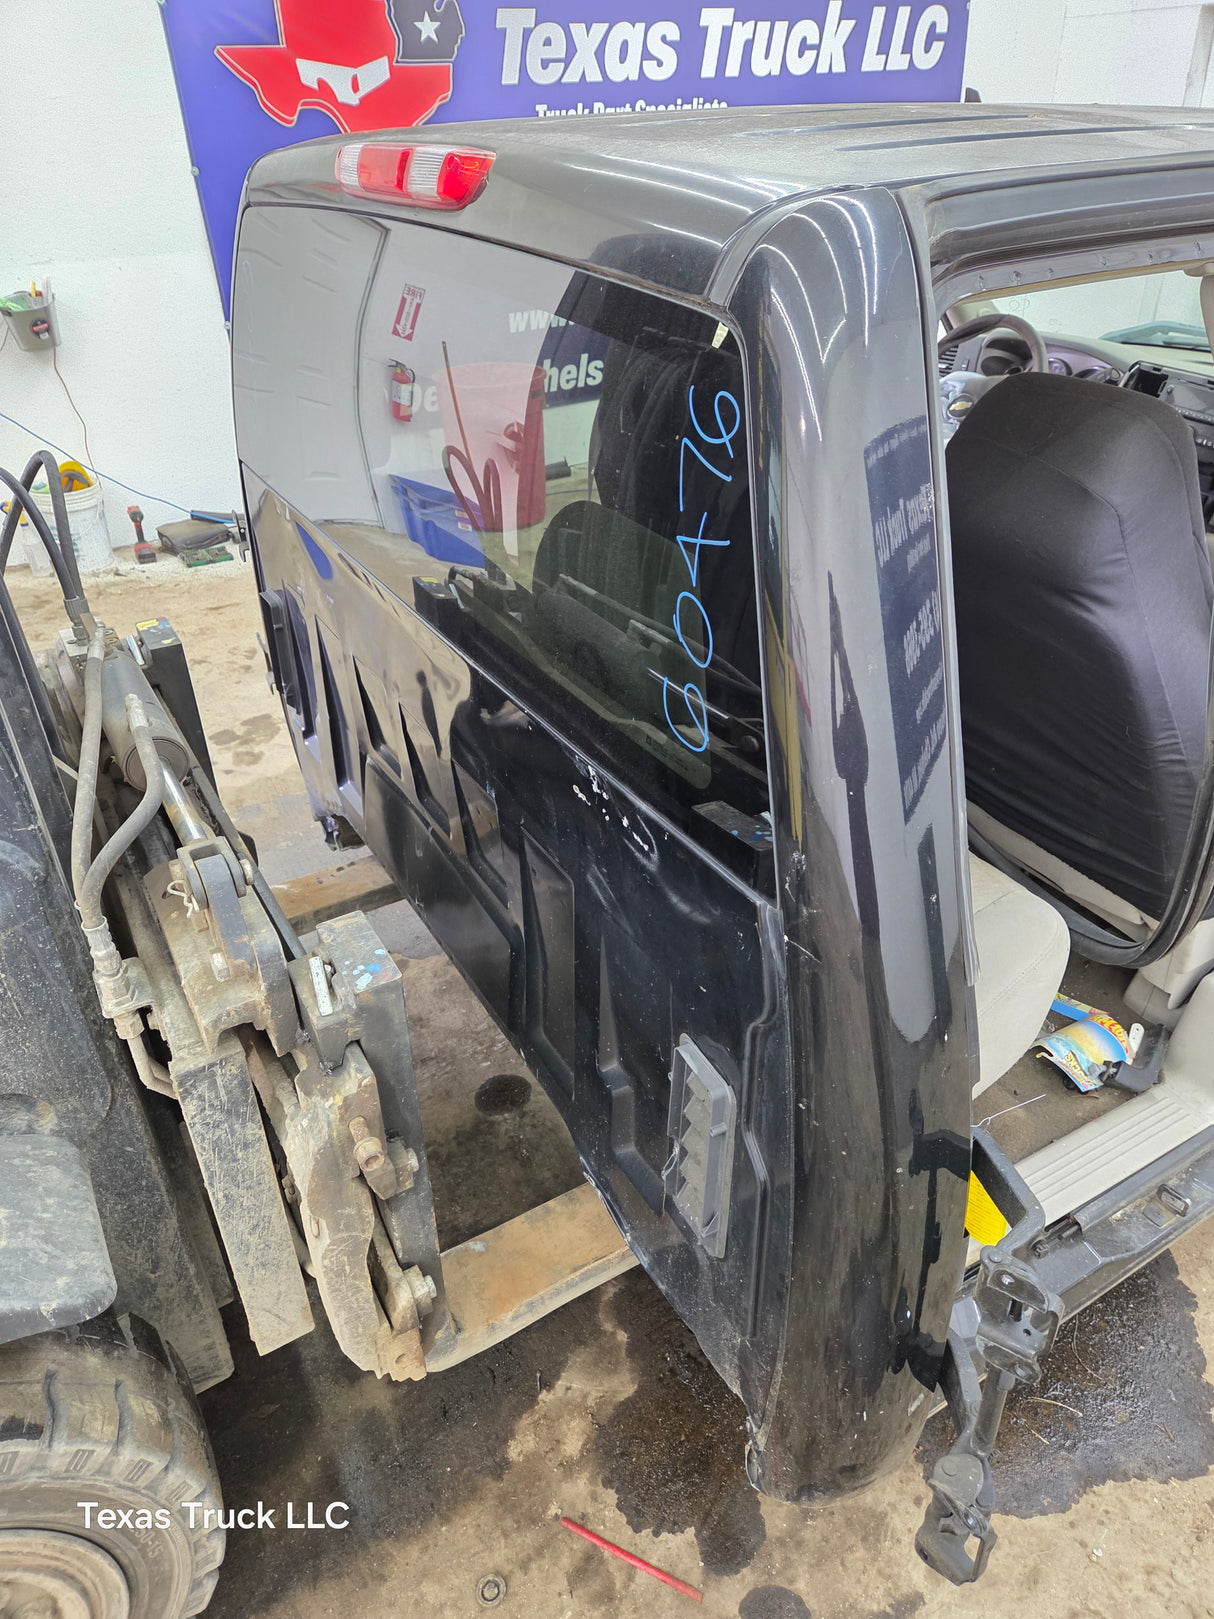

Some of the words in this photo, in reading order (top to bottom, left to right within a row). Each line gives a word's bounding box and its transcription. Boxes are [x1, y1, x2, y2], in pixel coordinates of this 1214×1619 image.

[495, 7, 680, 85] Texas
[698, 0, 857, 79] Truck
[860, 3, 949, 73] LLC
